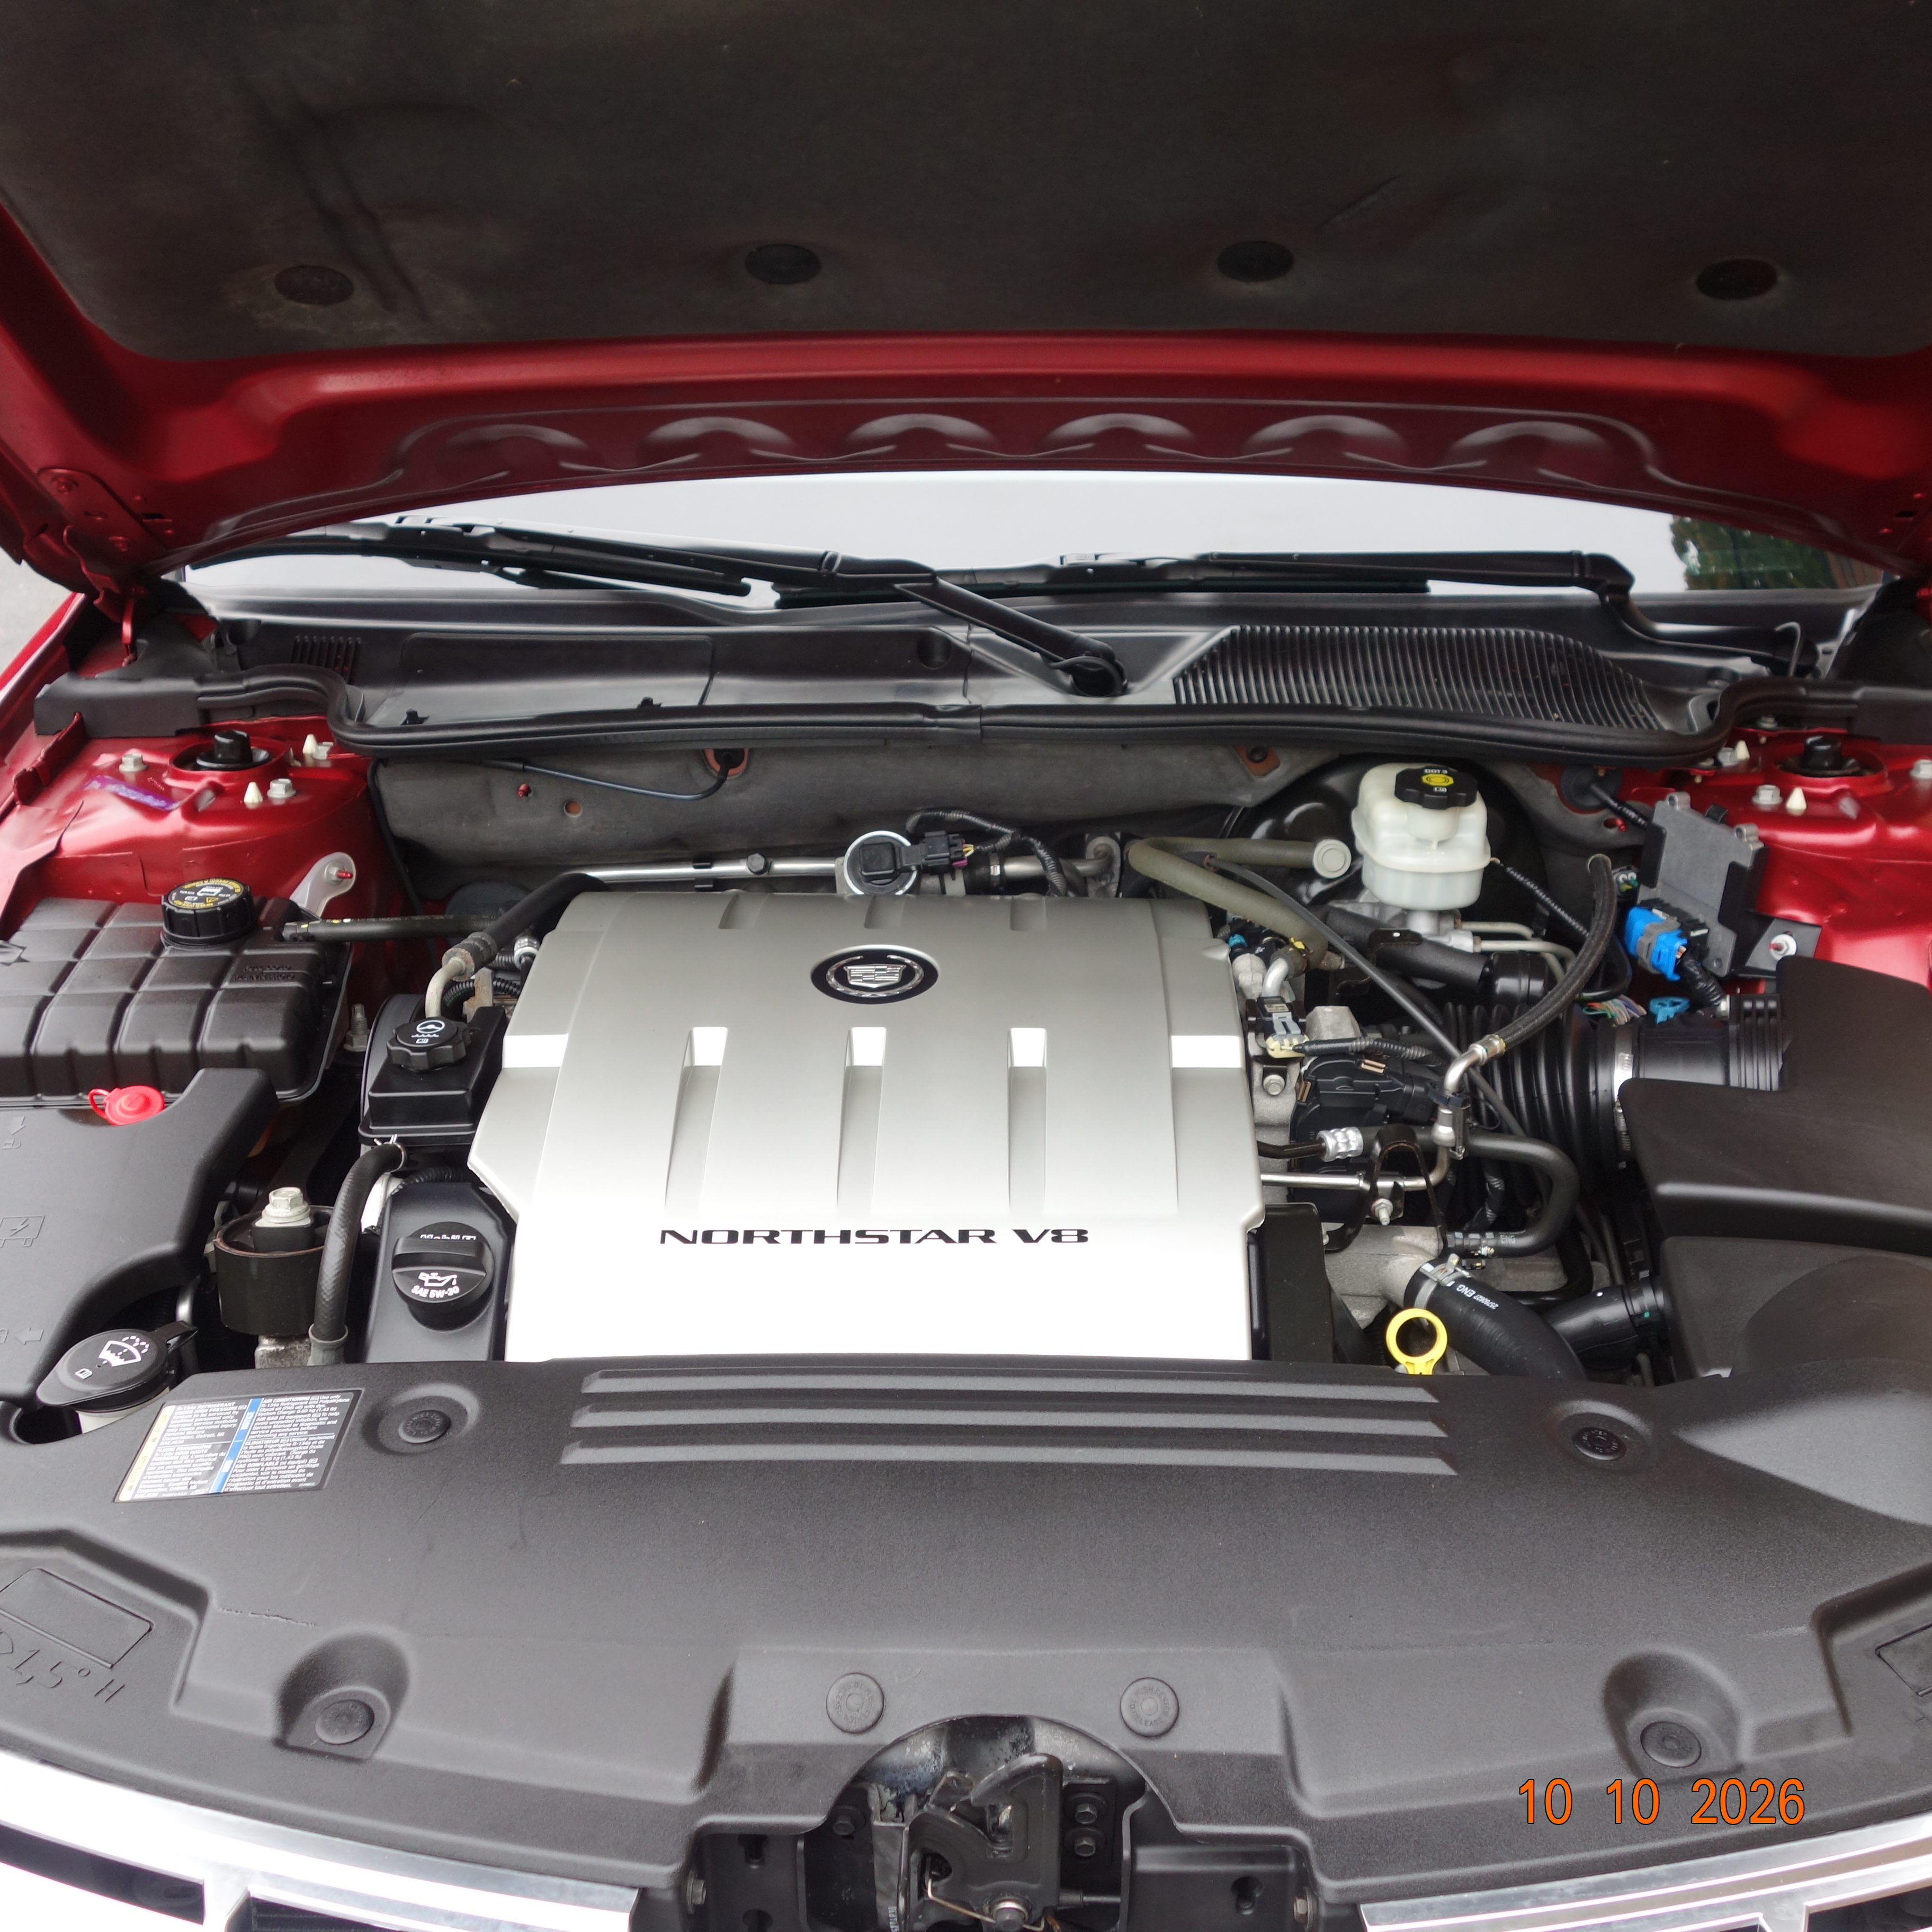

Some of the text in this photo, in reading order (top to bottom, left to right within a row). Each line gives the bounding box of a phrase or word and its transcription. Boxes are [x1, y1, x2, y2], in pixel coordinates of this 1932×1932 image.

[660, 1228, 1089, 1245] NORTHSTAR V8
[1500, 1235, 1516, 1244] ENG
[411, 1285, 460, 1299] SAE 5W-30
[1456, 1284, 1477, 1298] ENG
